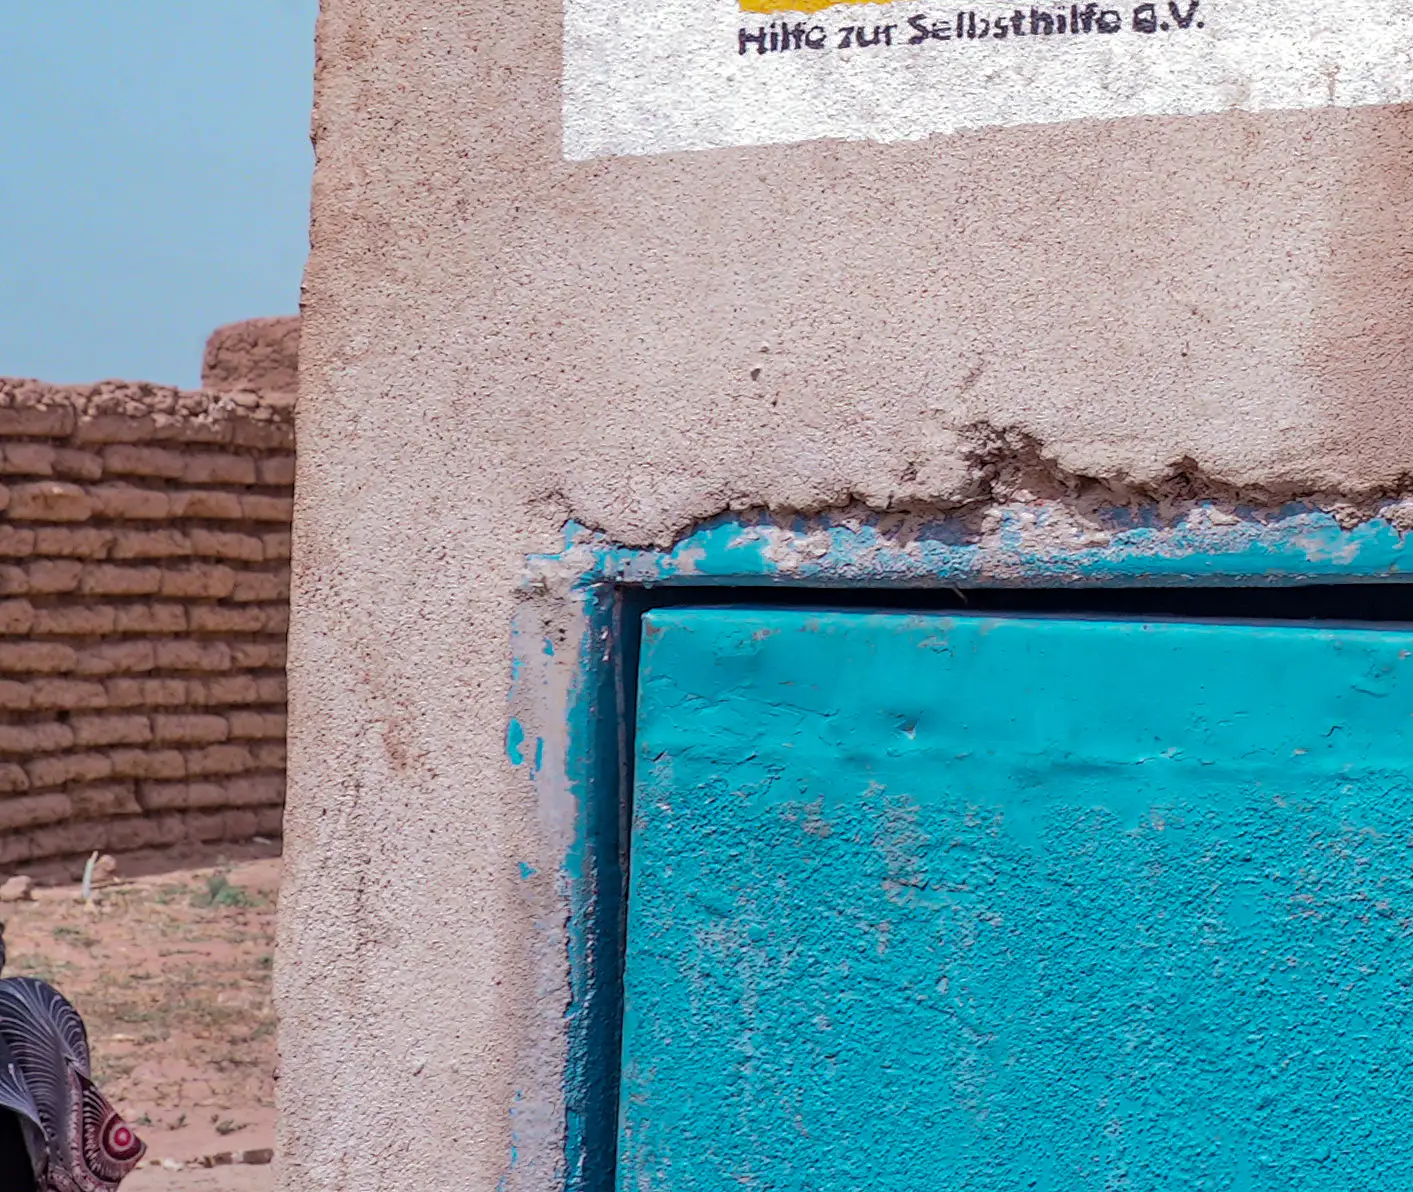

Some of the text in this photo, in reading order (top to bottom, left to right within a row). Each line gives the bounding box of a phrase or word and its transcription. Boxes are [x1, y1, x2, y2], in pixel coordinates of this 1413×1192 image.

[738, 21, 828, 56] Hilfe
[838, 23, 898, 49] zur
[907, 2, 1122, 46] Selbsthilfe
